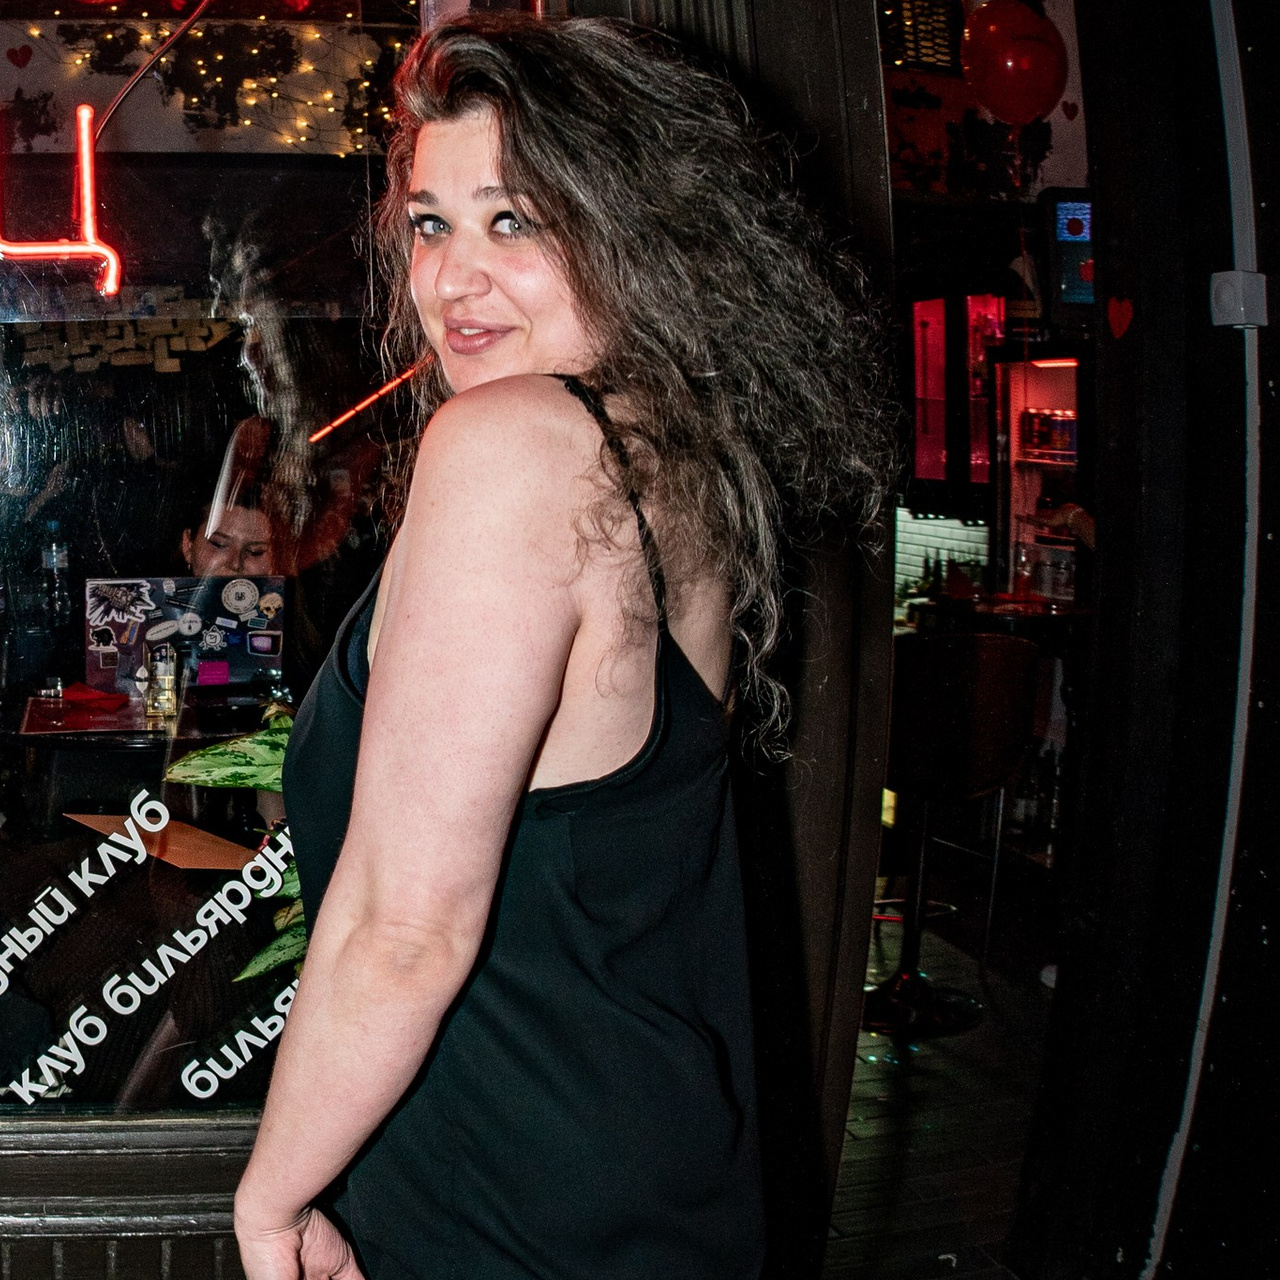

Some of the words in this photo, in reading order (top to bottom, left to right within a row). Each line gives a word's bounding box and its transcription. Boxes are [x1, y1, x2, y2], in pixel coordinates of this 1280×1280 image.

[67, 788, 170, 898] клуб
[9, 1004, 107, 1105] клуб
[181, 978, 300, 1098] билья
